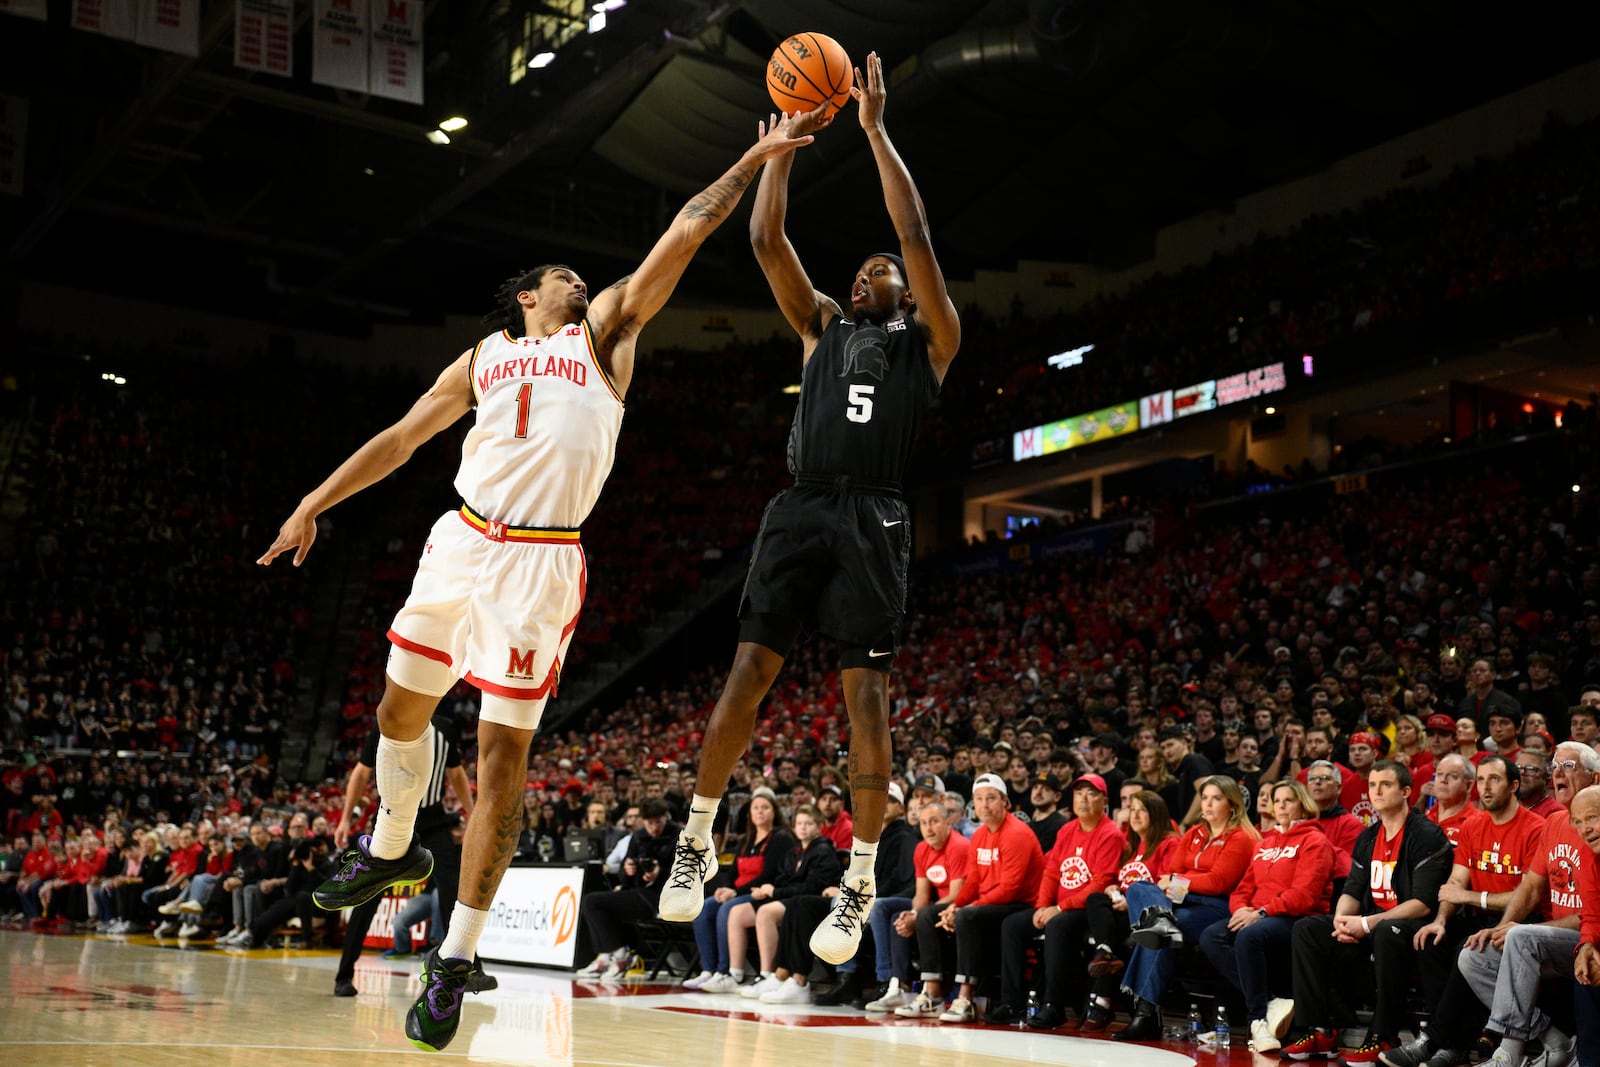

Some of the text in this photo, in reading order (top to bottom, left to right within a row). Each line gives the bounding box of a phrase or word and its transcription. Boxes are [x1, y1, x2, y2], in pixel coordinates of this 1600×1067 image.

[477, 355, 587, 395] MARYLAND
[514, 382, 533, 439] 1
[846, 384, 875, 424] 5
[1148, 394, 1165, 421] M
[1021, 430, 1035, 457] M
[488, 521, 504, 539] M
[506, 646, 537, 676] M
